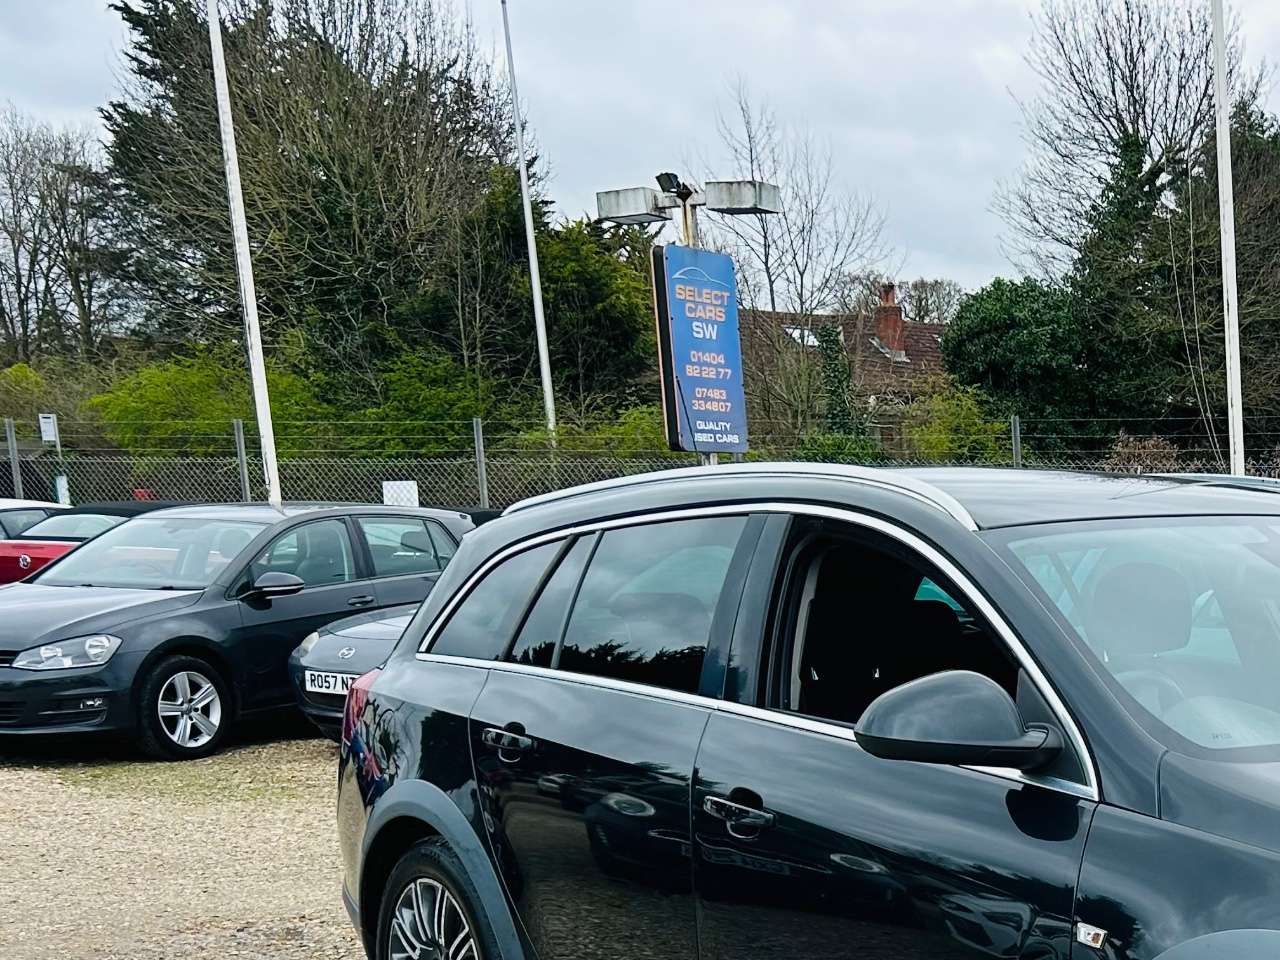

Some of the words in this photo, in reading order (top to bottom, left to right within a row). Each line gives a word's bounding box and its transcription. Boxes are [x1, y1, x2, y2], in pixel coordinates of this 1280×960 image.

[675, 284, 730, 306] SELECT
[685, 303, 726, 322] CARS
[692, 321, 718, 340] SW
[690, 350, 725, 364] 01404
[696, 420, 731, 431] QUALITY
[715, 433, 739, 443] CARS
[309, 673, 337, 690] RO57
